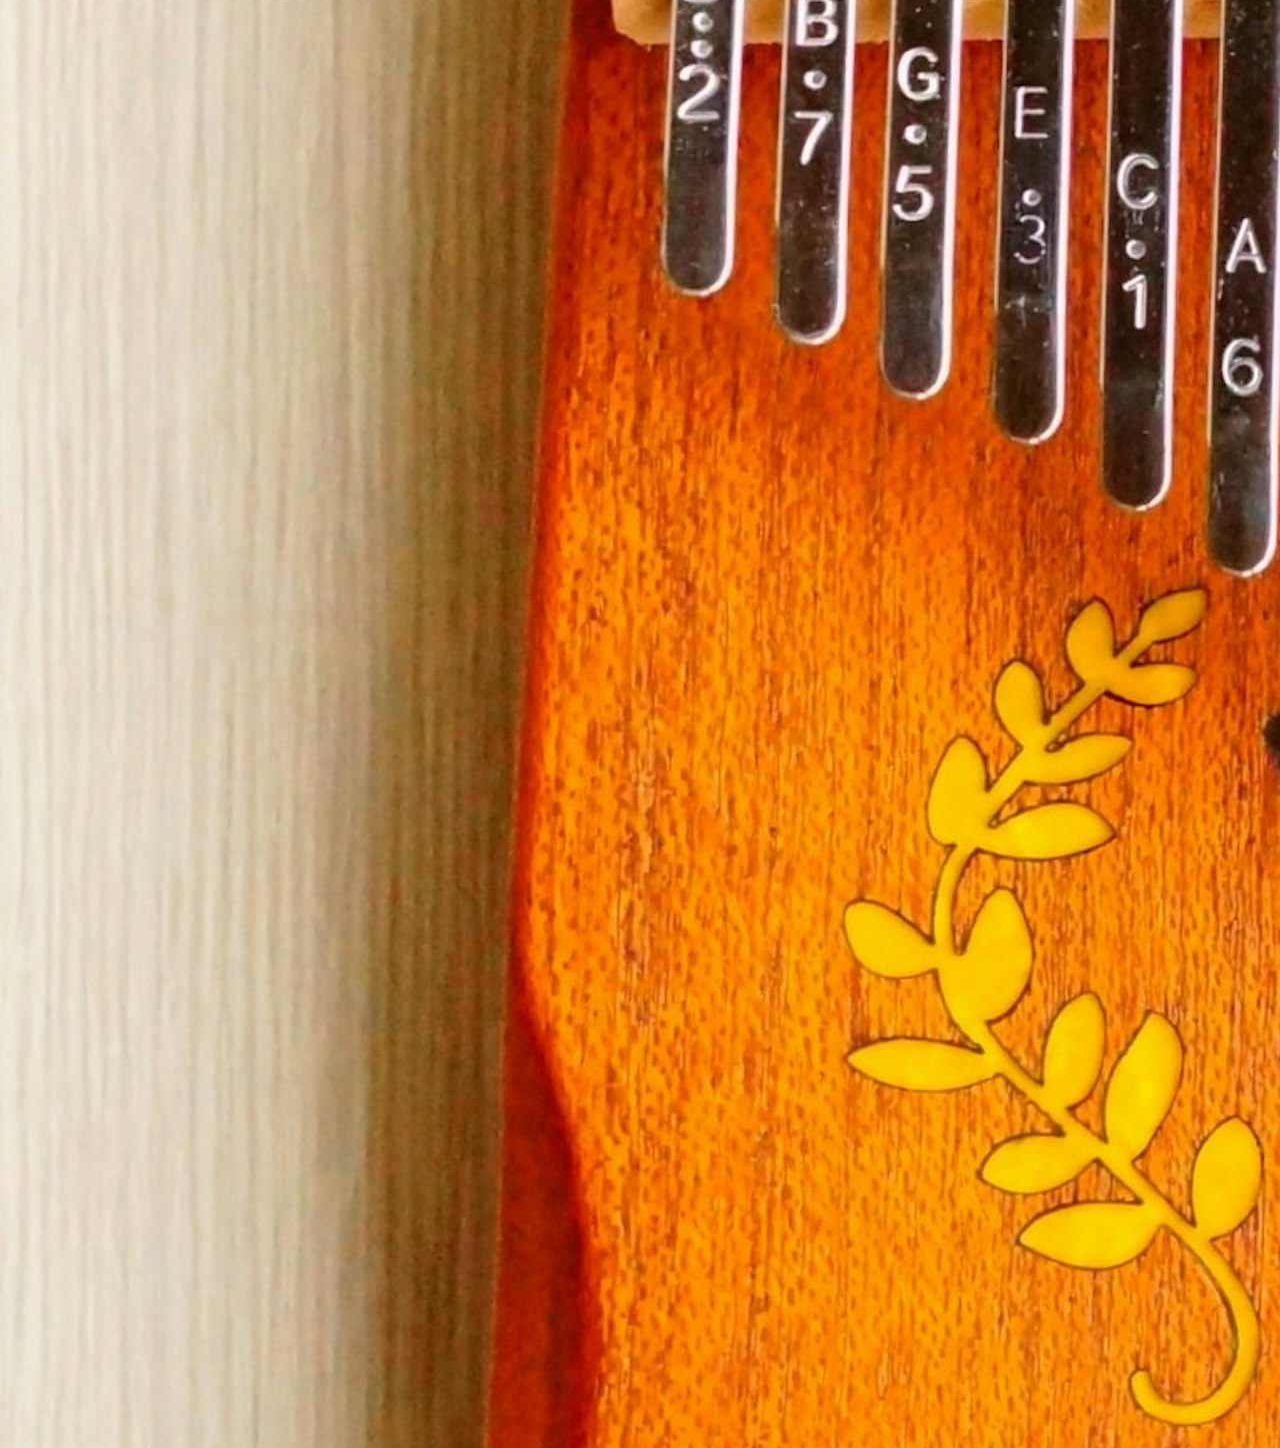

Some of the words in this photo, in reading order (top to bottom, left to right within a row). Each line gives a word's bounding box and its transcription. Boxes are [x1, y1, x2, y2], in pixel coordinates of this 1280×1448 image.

[677, 65, 721, 123] 2
[897, 47, 940, 101] G
[794, 111, 833, 165] 7
[1014, 87, 1048, 139] E
[893, 165, 934, 220] 5
[1117, 153, 1158, 209] C
[1013, 215, 1046, 264] 3
[1225, 218, 1267, 273] A
[1123, 274, 1147, 328] 1
[1222, 339, 1263, 396] 6
